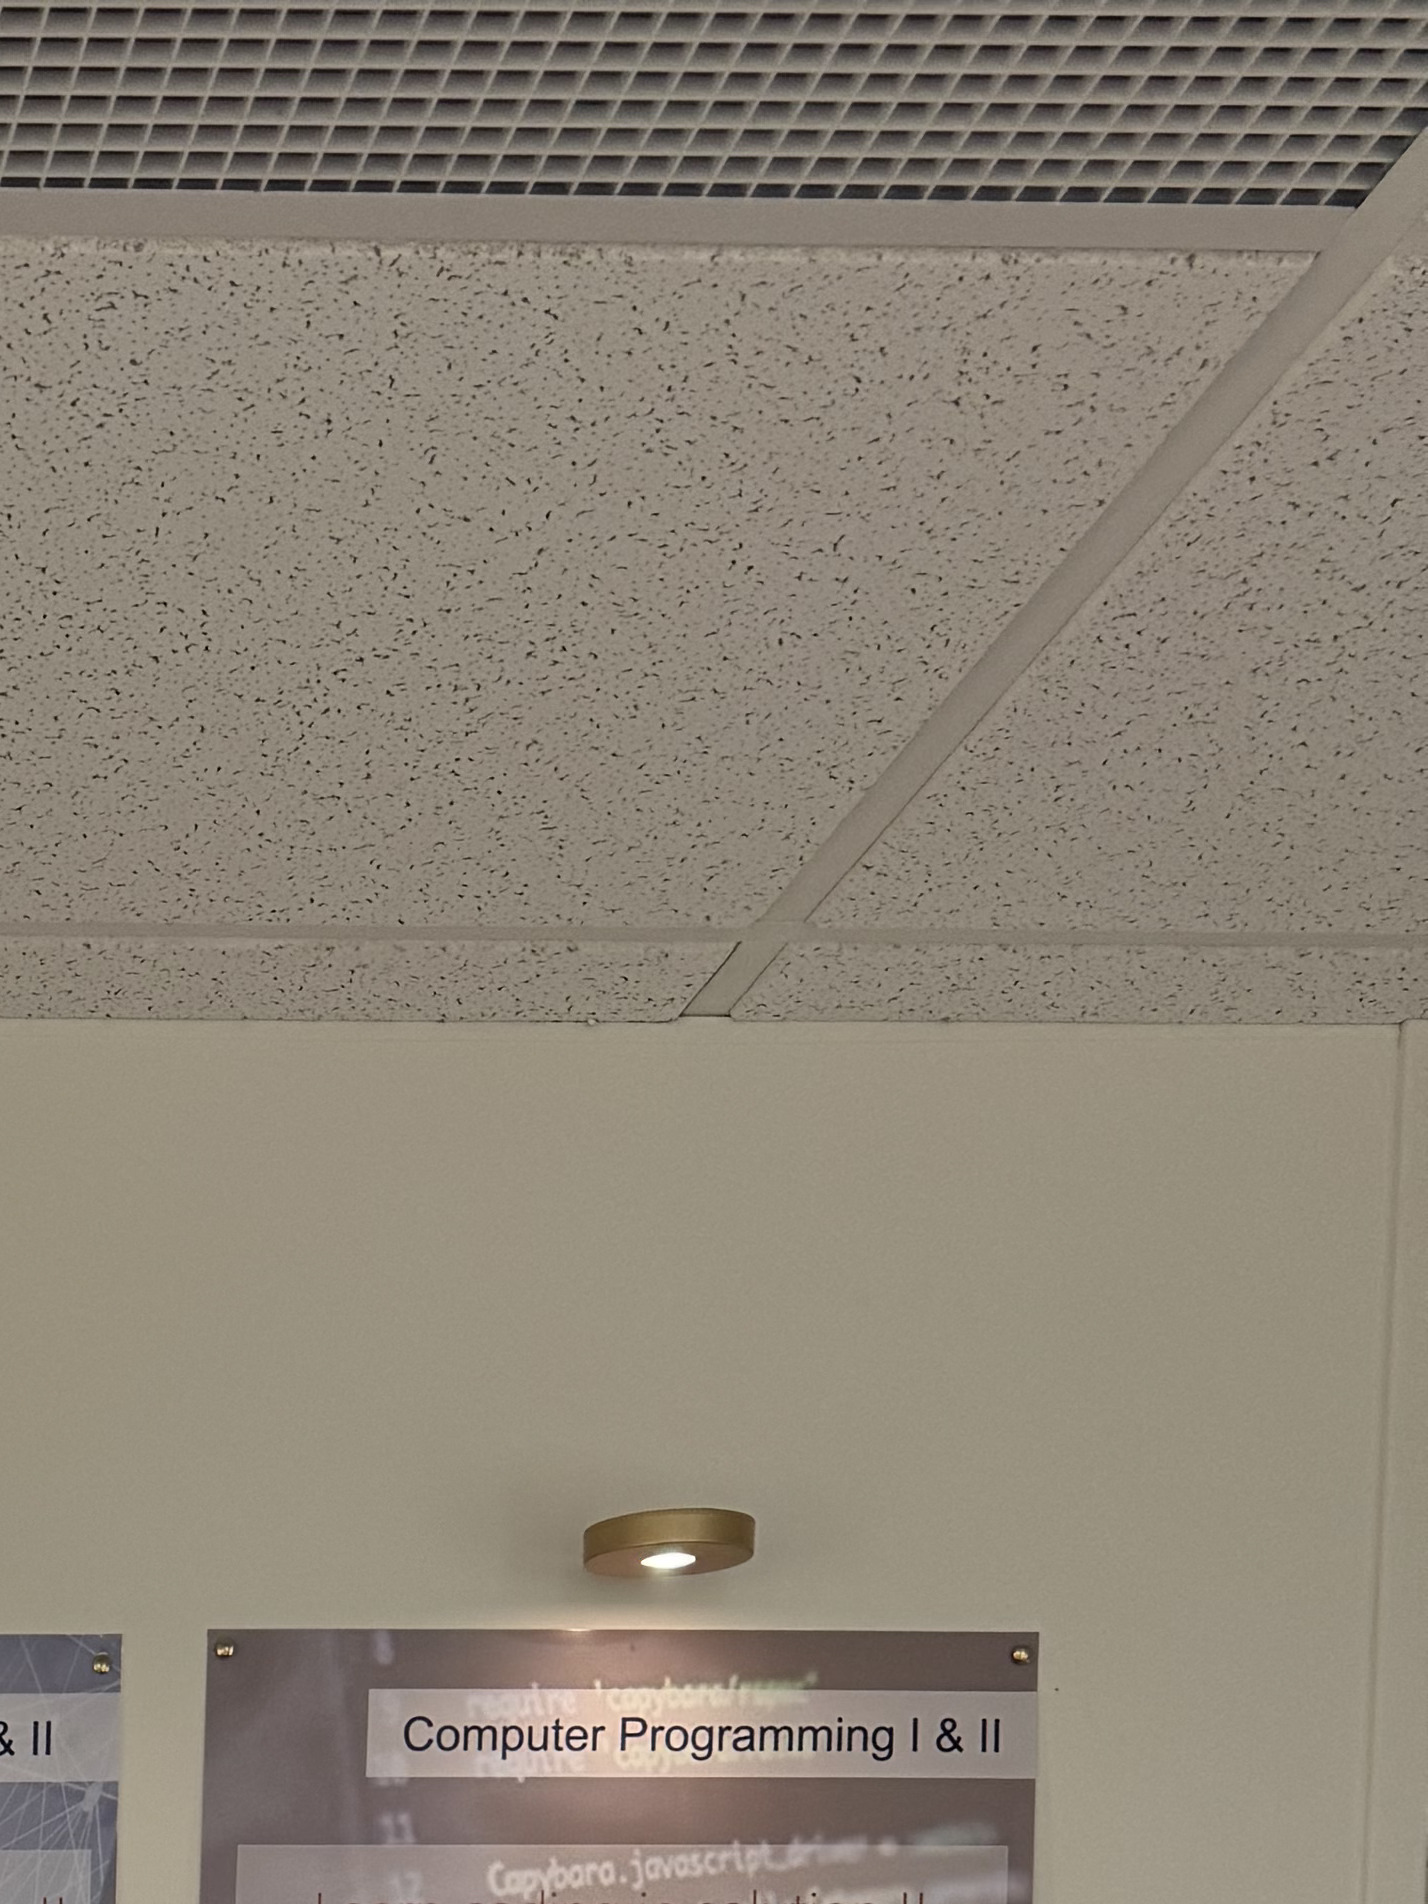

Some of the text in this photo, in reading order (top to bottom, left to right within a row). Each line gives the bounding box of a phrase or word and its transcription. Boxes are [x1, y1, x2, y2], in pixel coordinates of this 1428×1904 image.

[32, 1720, 52, 1756] II
[403, 1715, 1000, 1762] Computer Programming I & II
